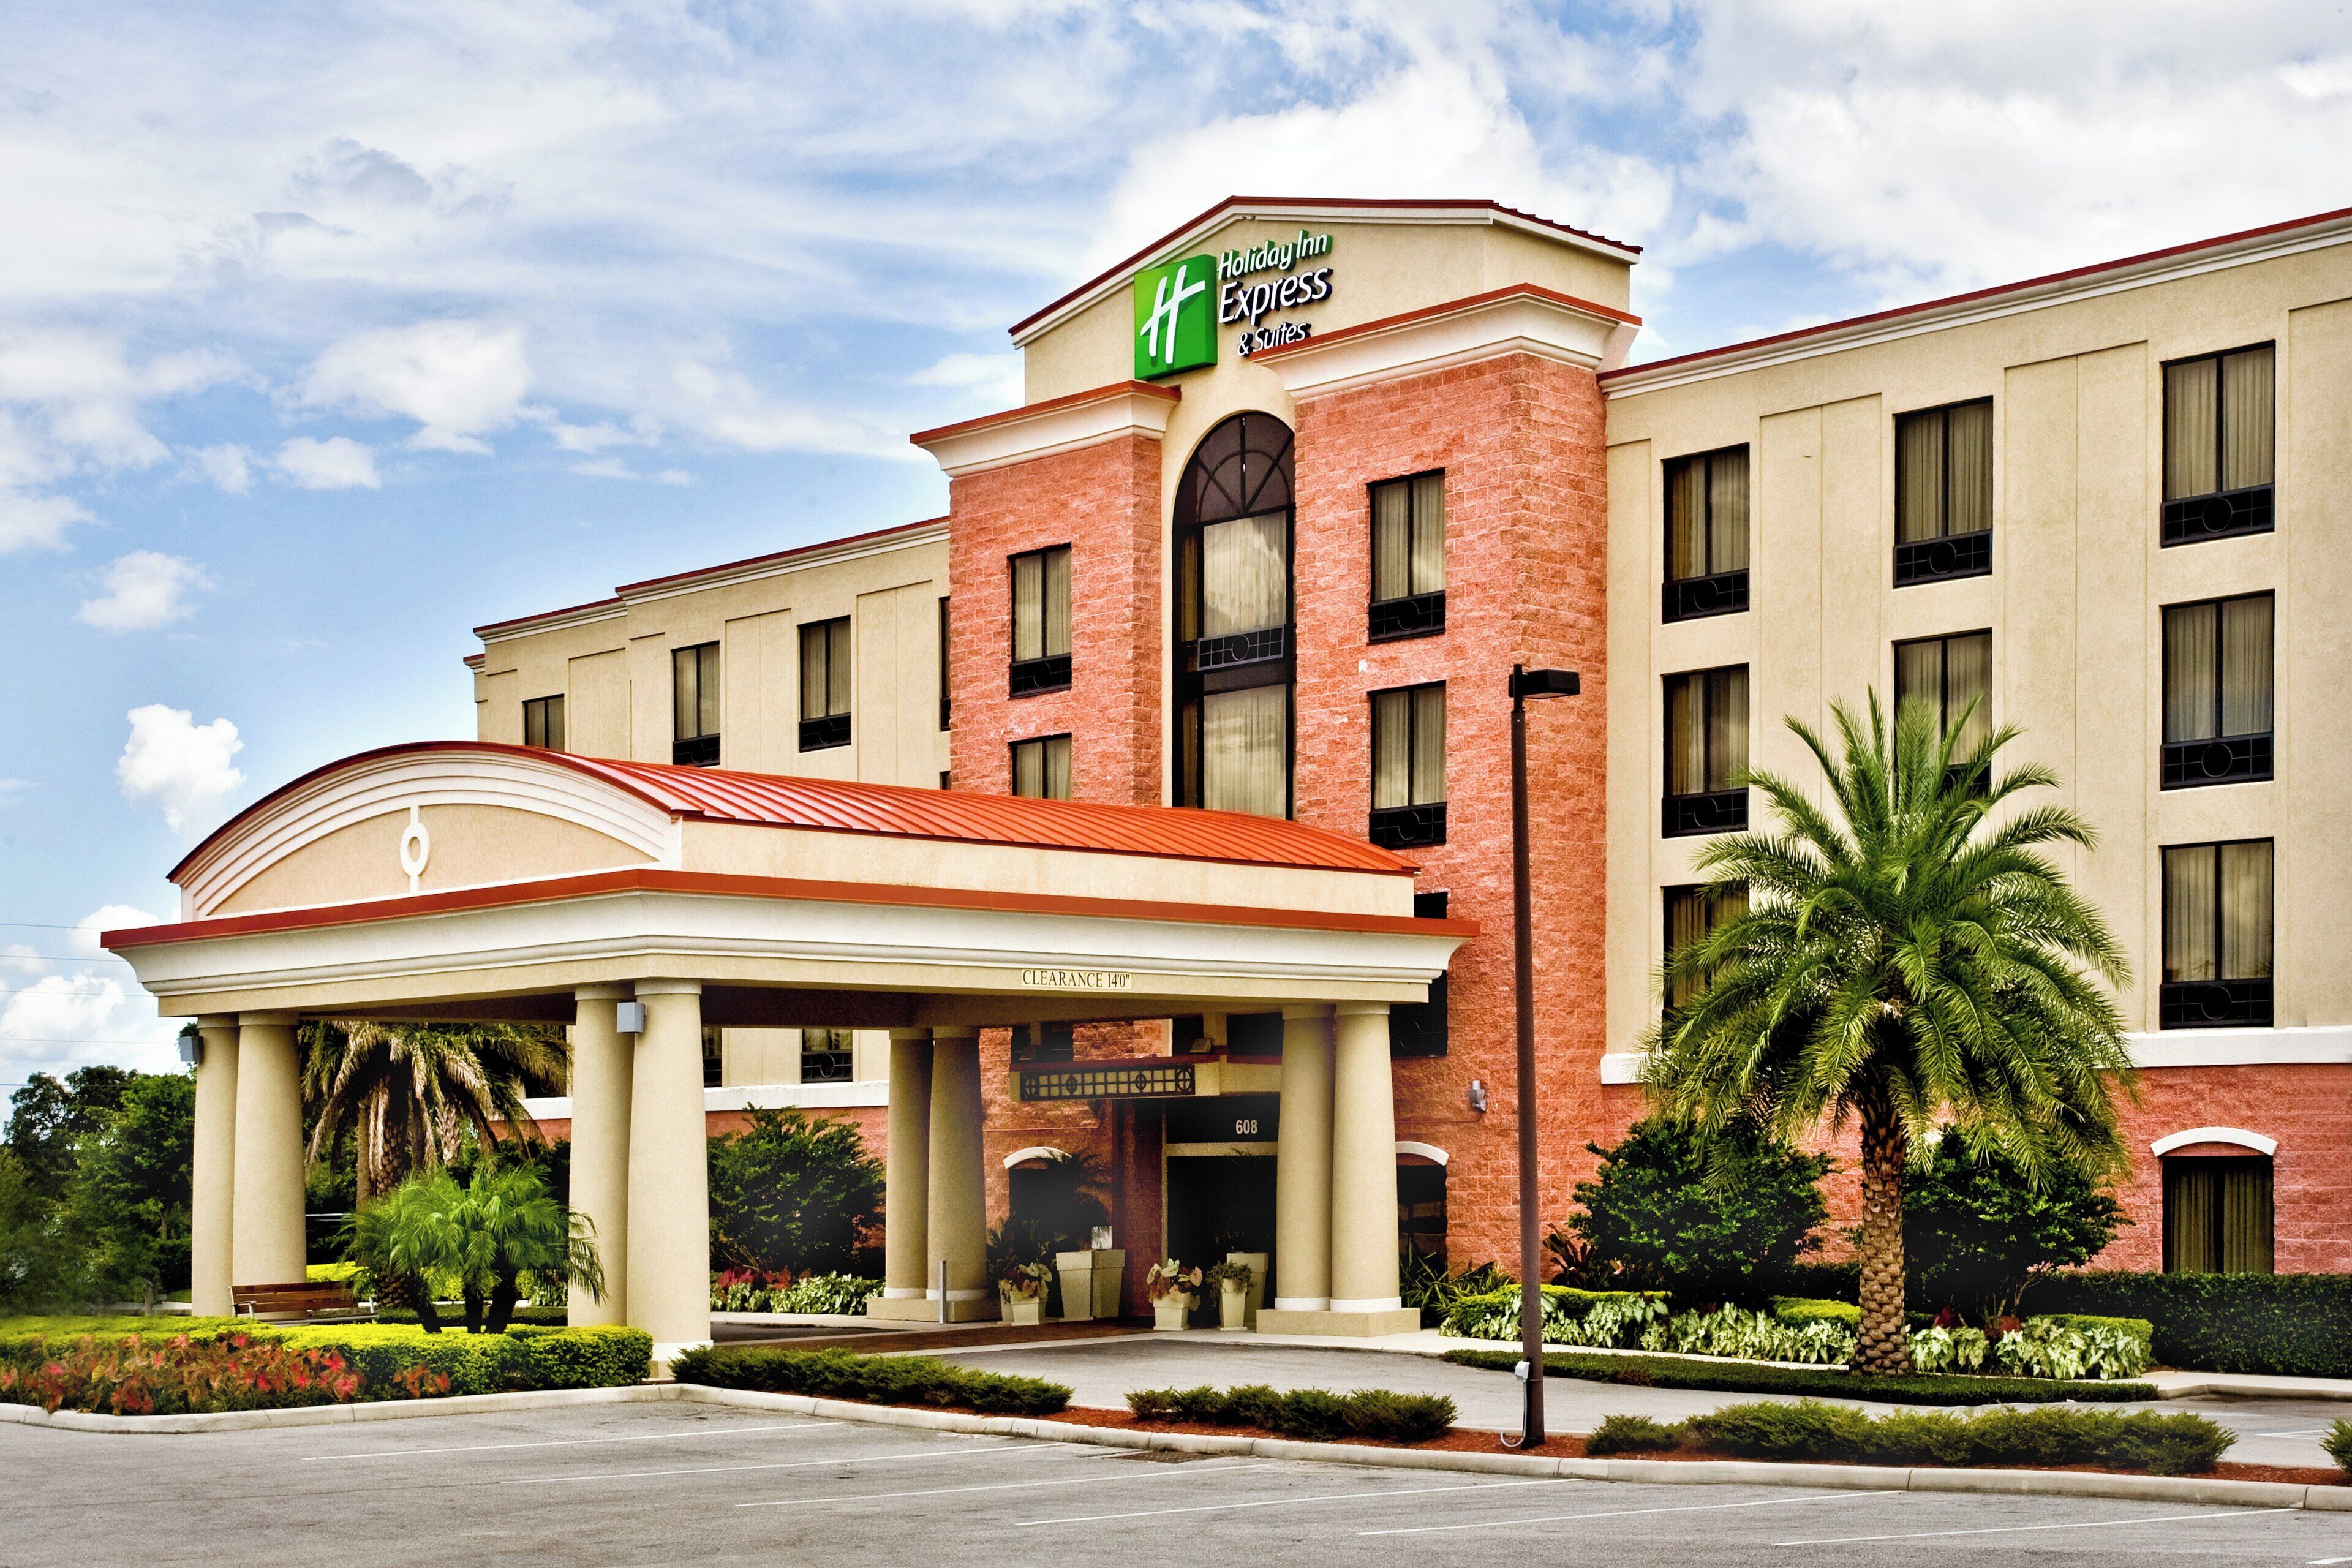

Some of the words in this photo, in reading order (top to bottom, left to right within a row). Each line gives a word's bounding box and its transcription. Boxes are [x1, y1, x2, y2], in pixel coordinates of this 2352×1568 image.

[1217, 239, 1295, 281] Holiday
[1296, 230, 1329, 258] Inn
[1218, 268, 1331, 326] Express
[1237, 332, 1250, 357] &
[1253, 323, 1308, 353] Suites
[1023, 970, 1103, 987] CLEARANCE
[1107, 973, 1130, 988] 14'0"
[1235, 1119, 1258, 1134] 608
